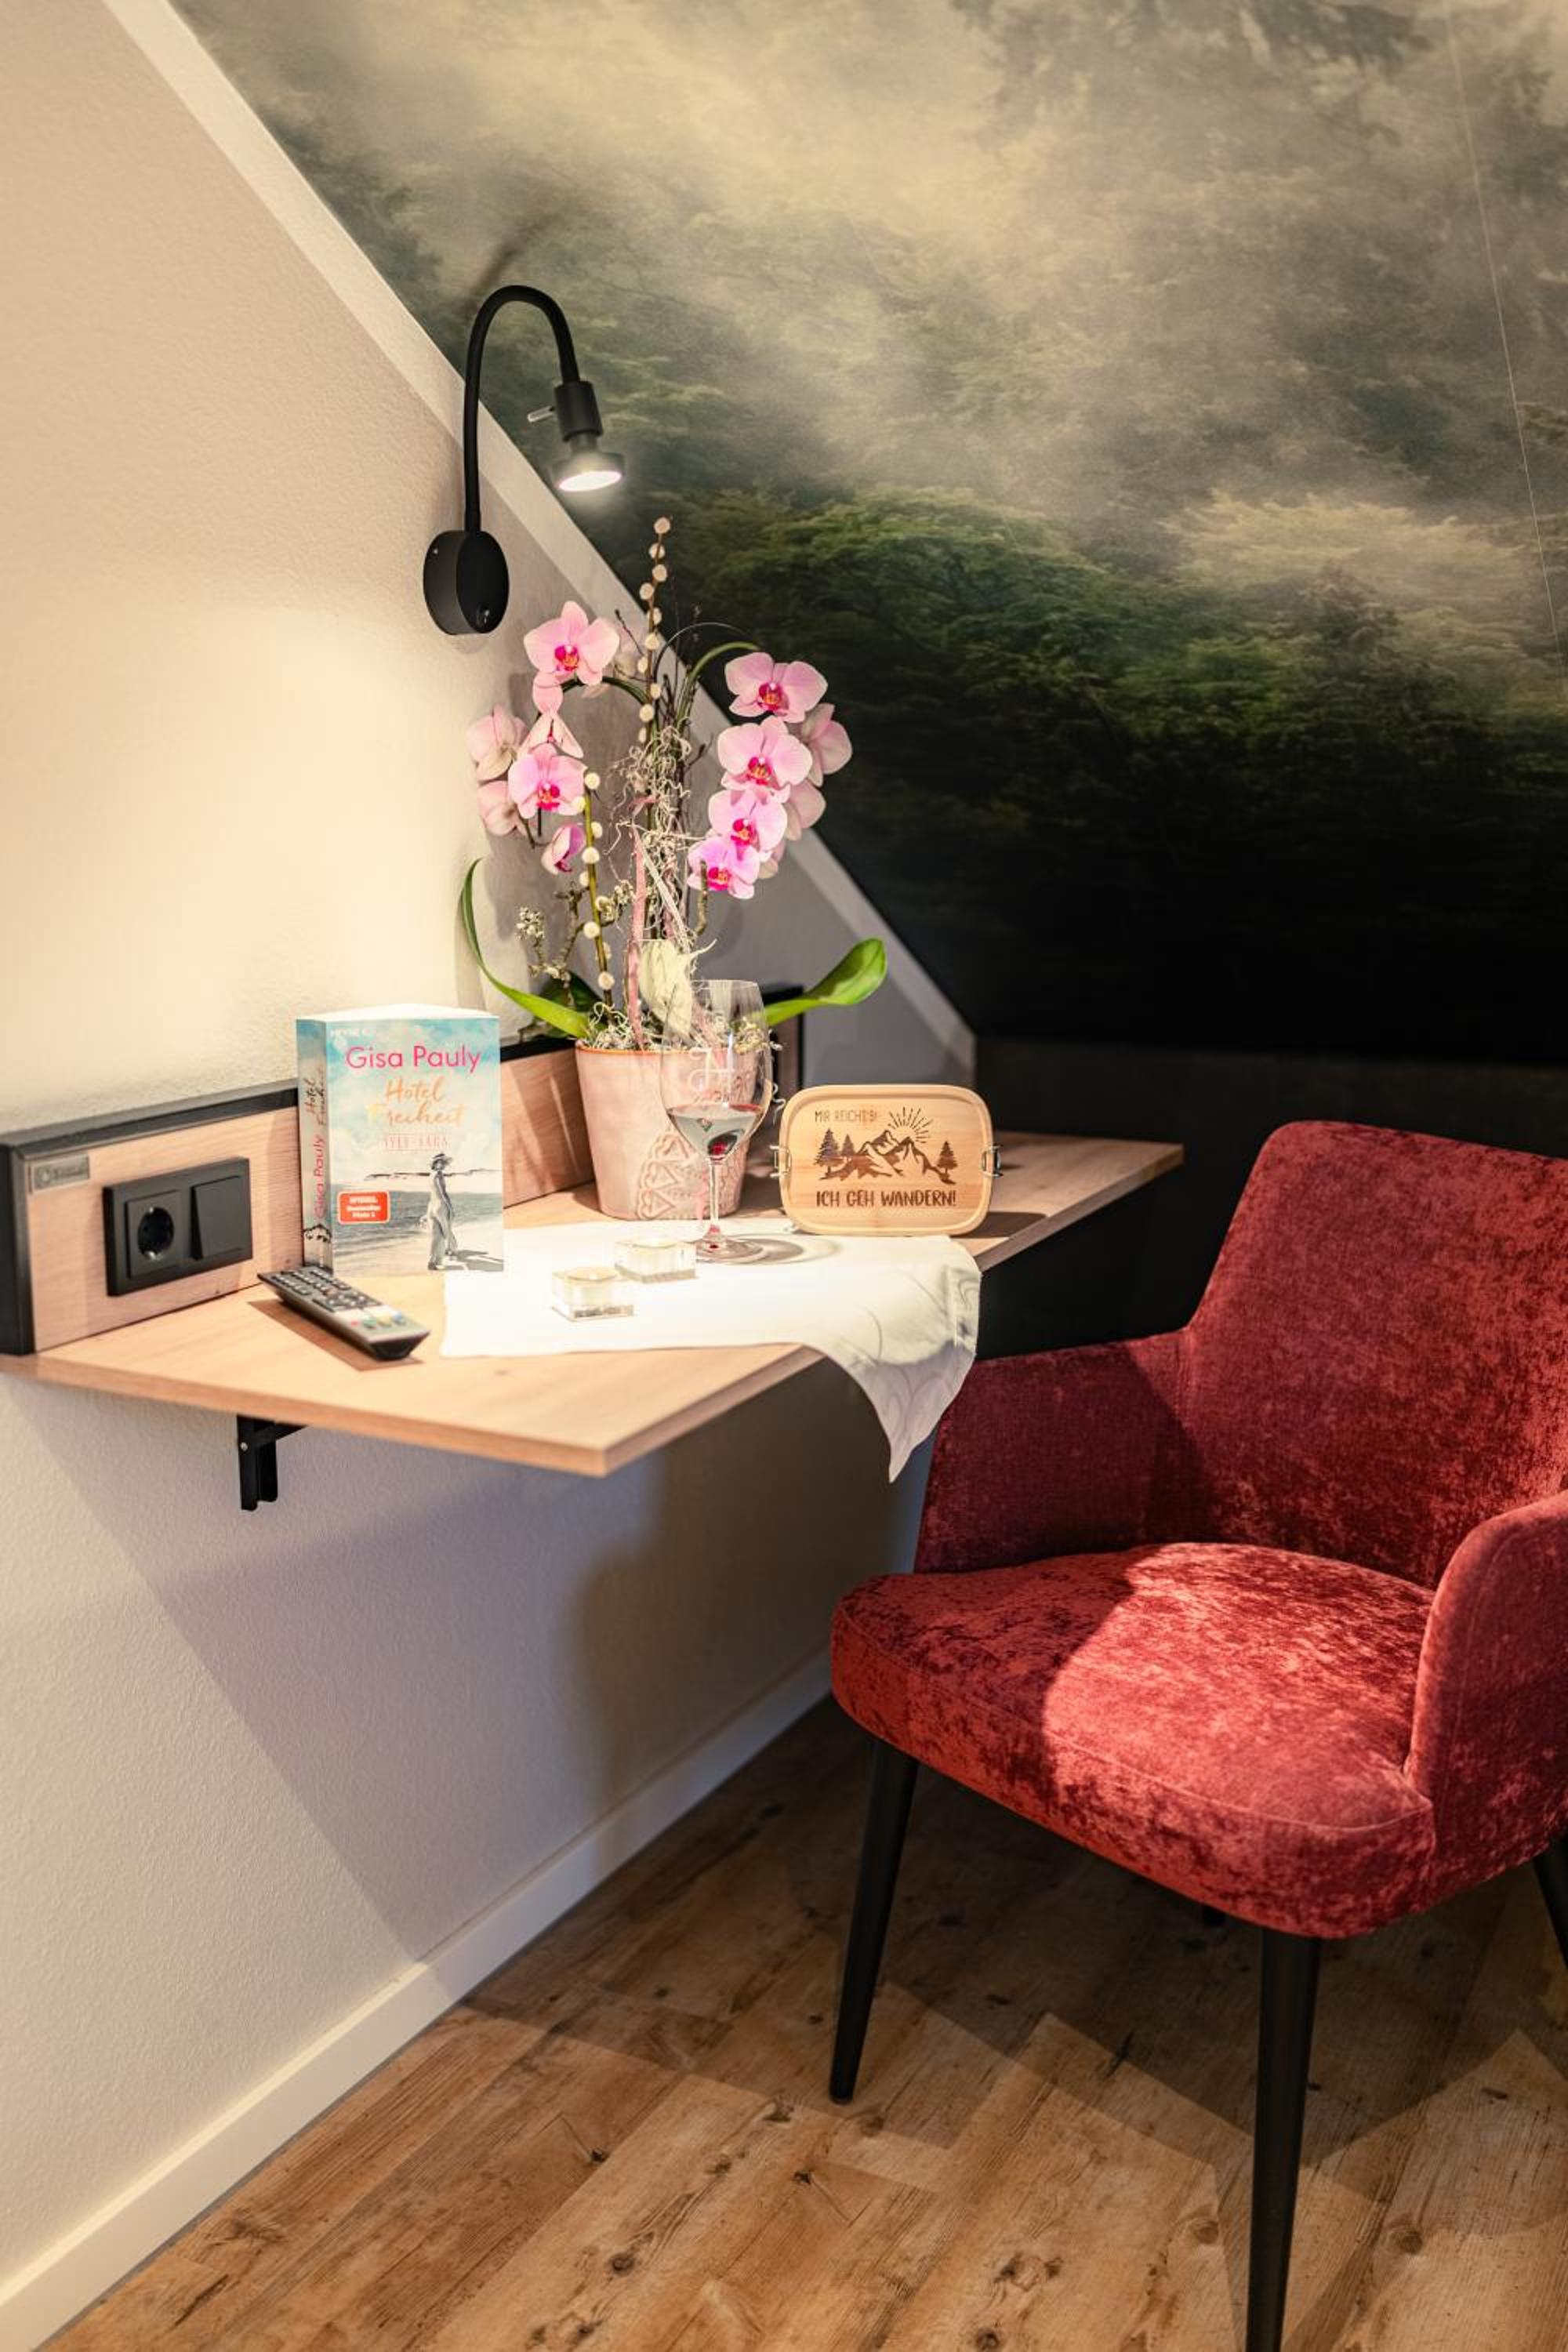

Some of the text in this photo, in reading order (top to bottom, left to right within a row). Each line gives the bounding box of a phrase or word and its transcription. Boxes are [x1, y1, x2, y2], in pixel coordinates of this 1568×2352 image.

[345, 1044, 481, 1074] Gisa Pauly
[384, 1076, 445, 1102] Hotel
[815, 1110, 830, 1123] MIR
[313, 1134, 325, 1177] Pauly
[815, 1189, 957, 1207] ICH GEH WANDERN!
